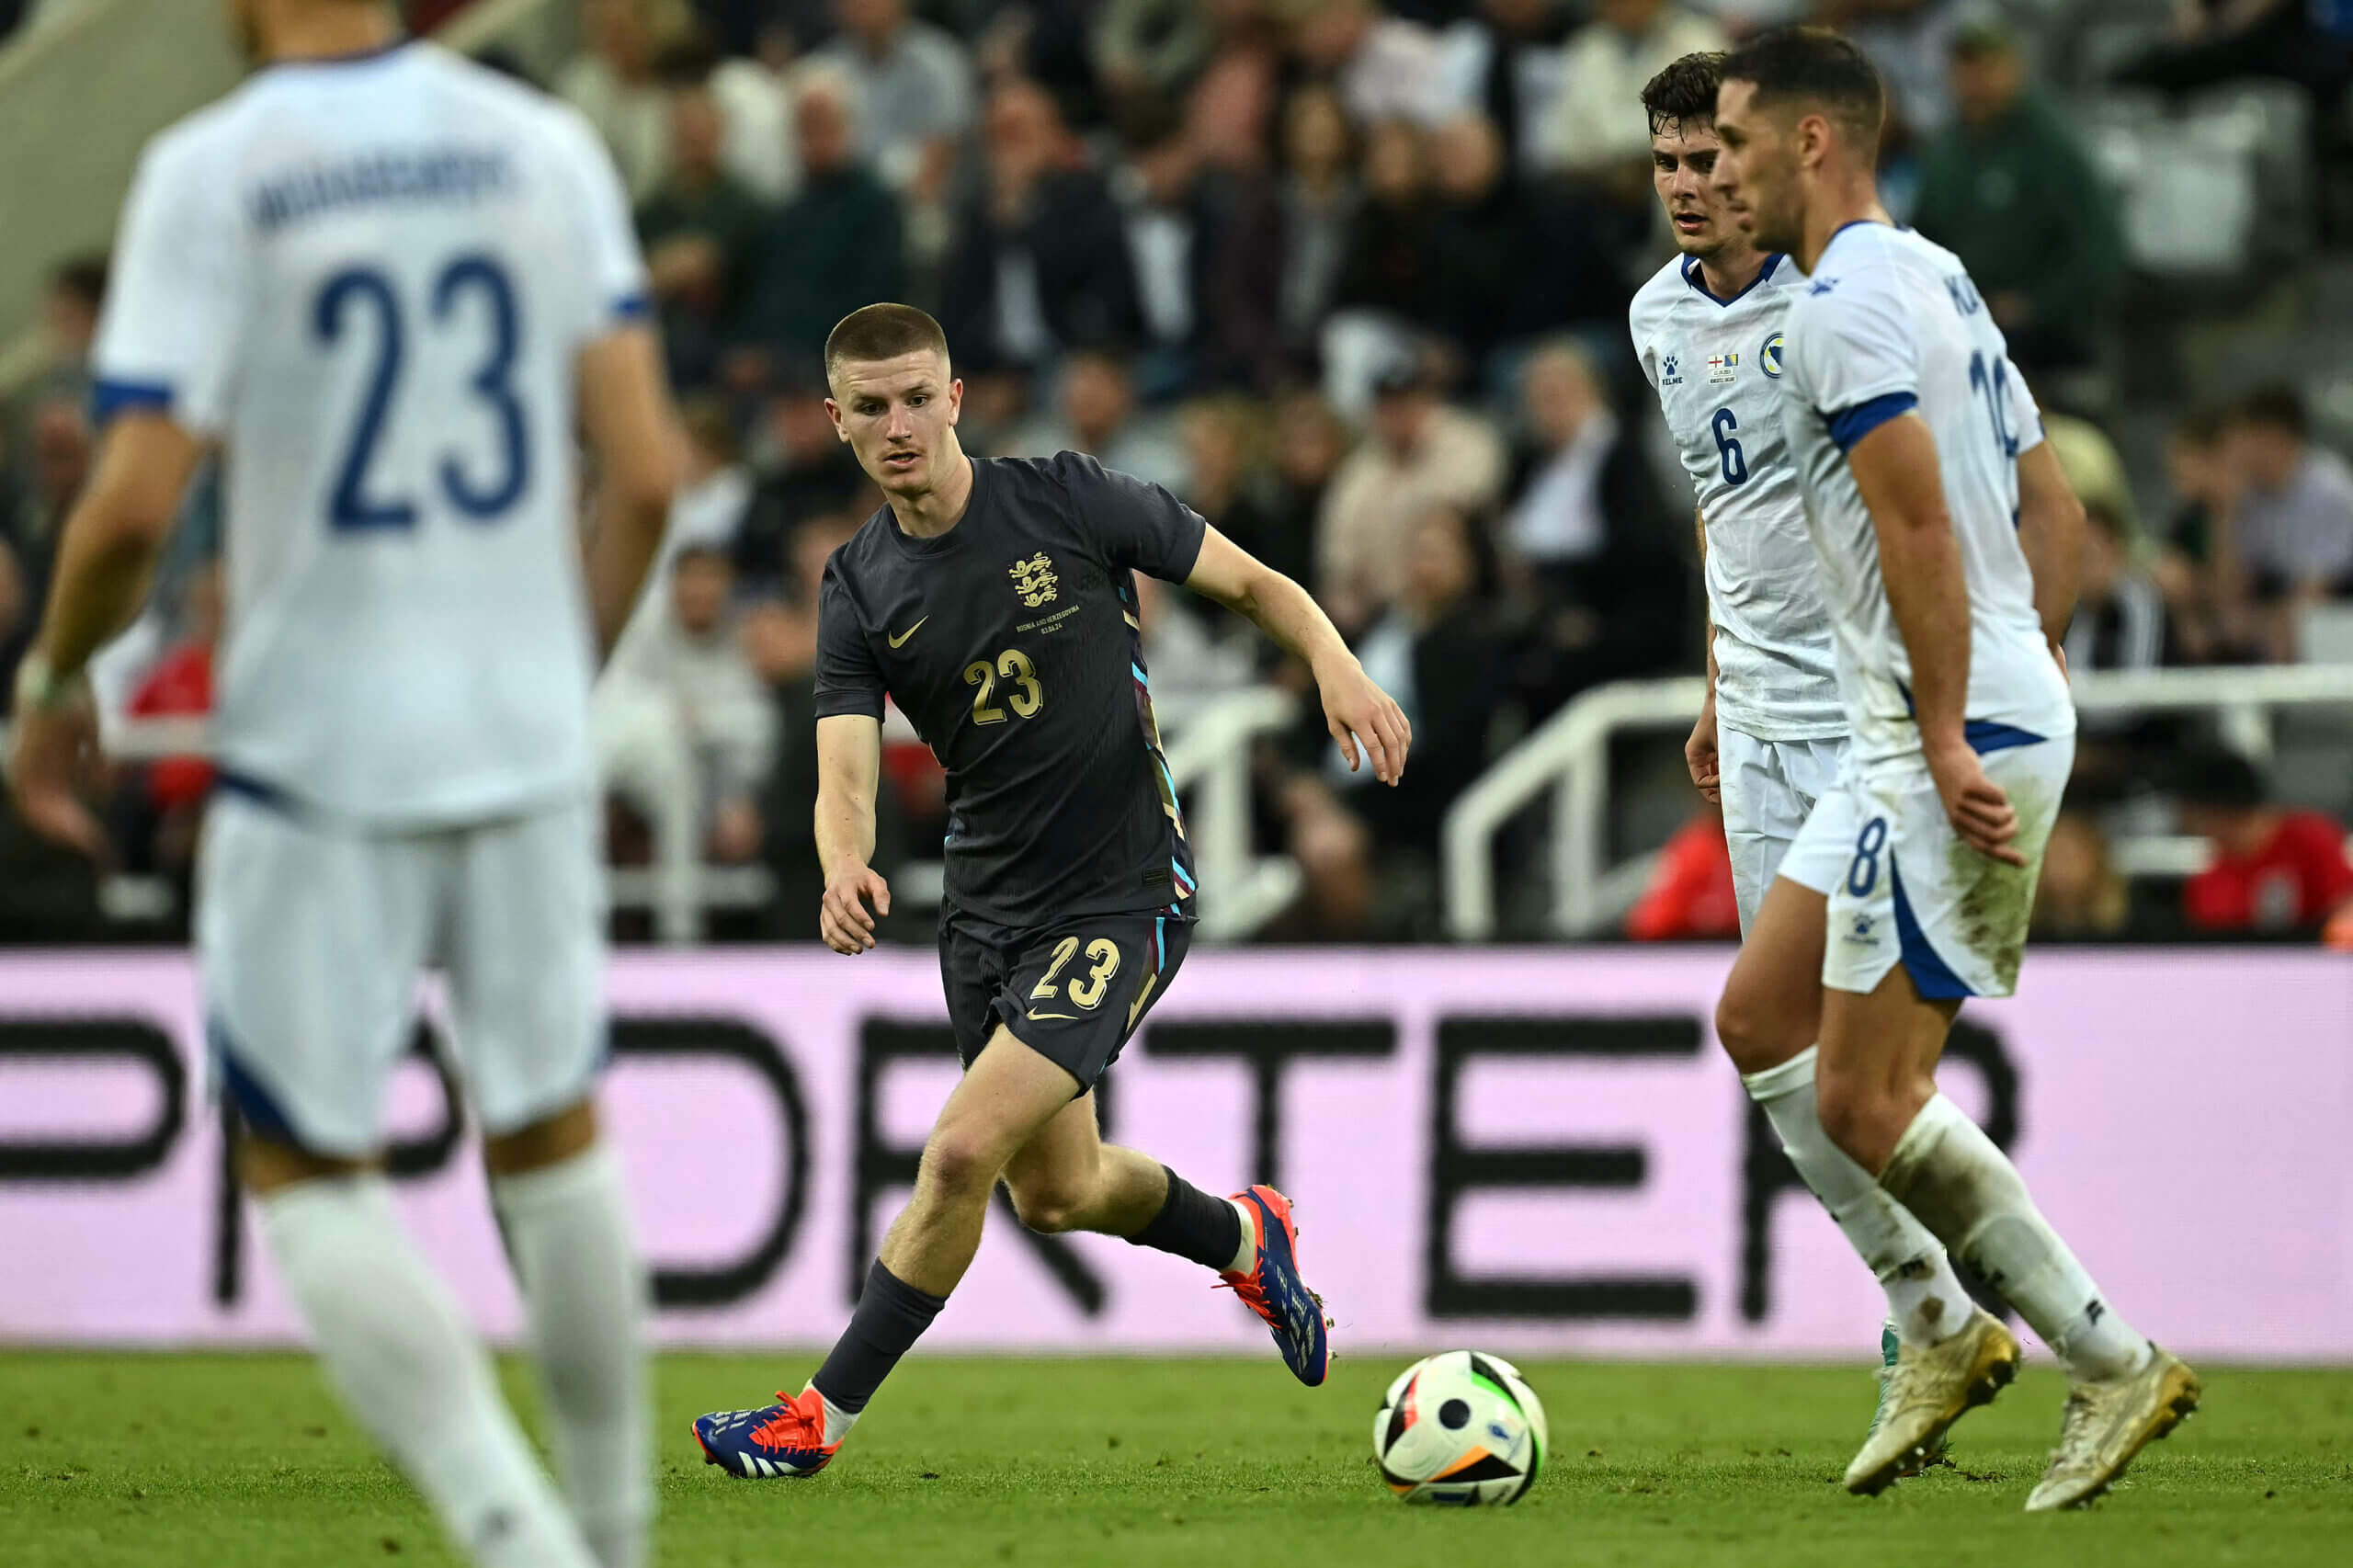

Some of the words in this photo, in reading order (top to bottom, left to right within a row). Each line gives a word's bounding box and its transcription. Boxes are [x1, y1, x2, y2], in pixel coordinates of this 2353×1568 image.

[312, 254, 532, 533] 23
[1662, 376, 1684, 386] KELME
[1711, 408, 1748, 485] 6
[1017, 622, 1036, 632] BOSNIA
[1036, 619, 1047, 627] AND
[1047, 604, 1080, 623] HERZEGOVINA
[963, 648, 1043, 725] 23
[1847, 816, 1887, 898] 8
[1029, 936, 1120, 1010] 23
